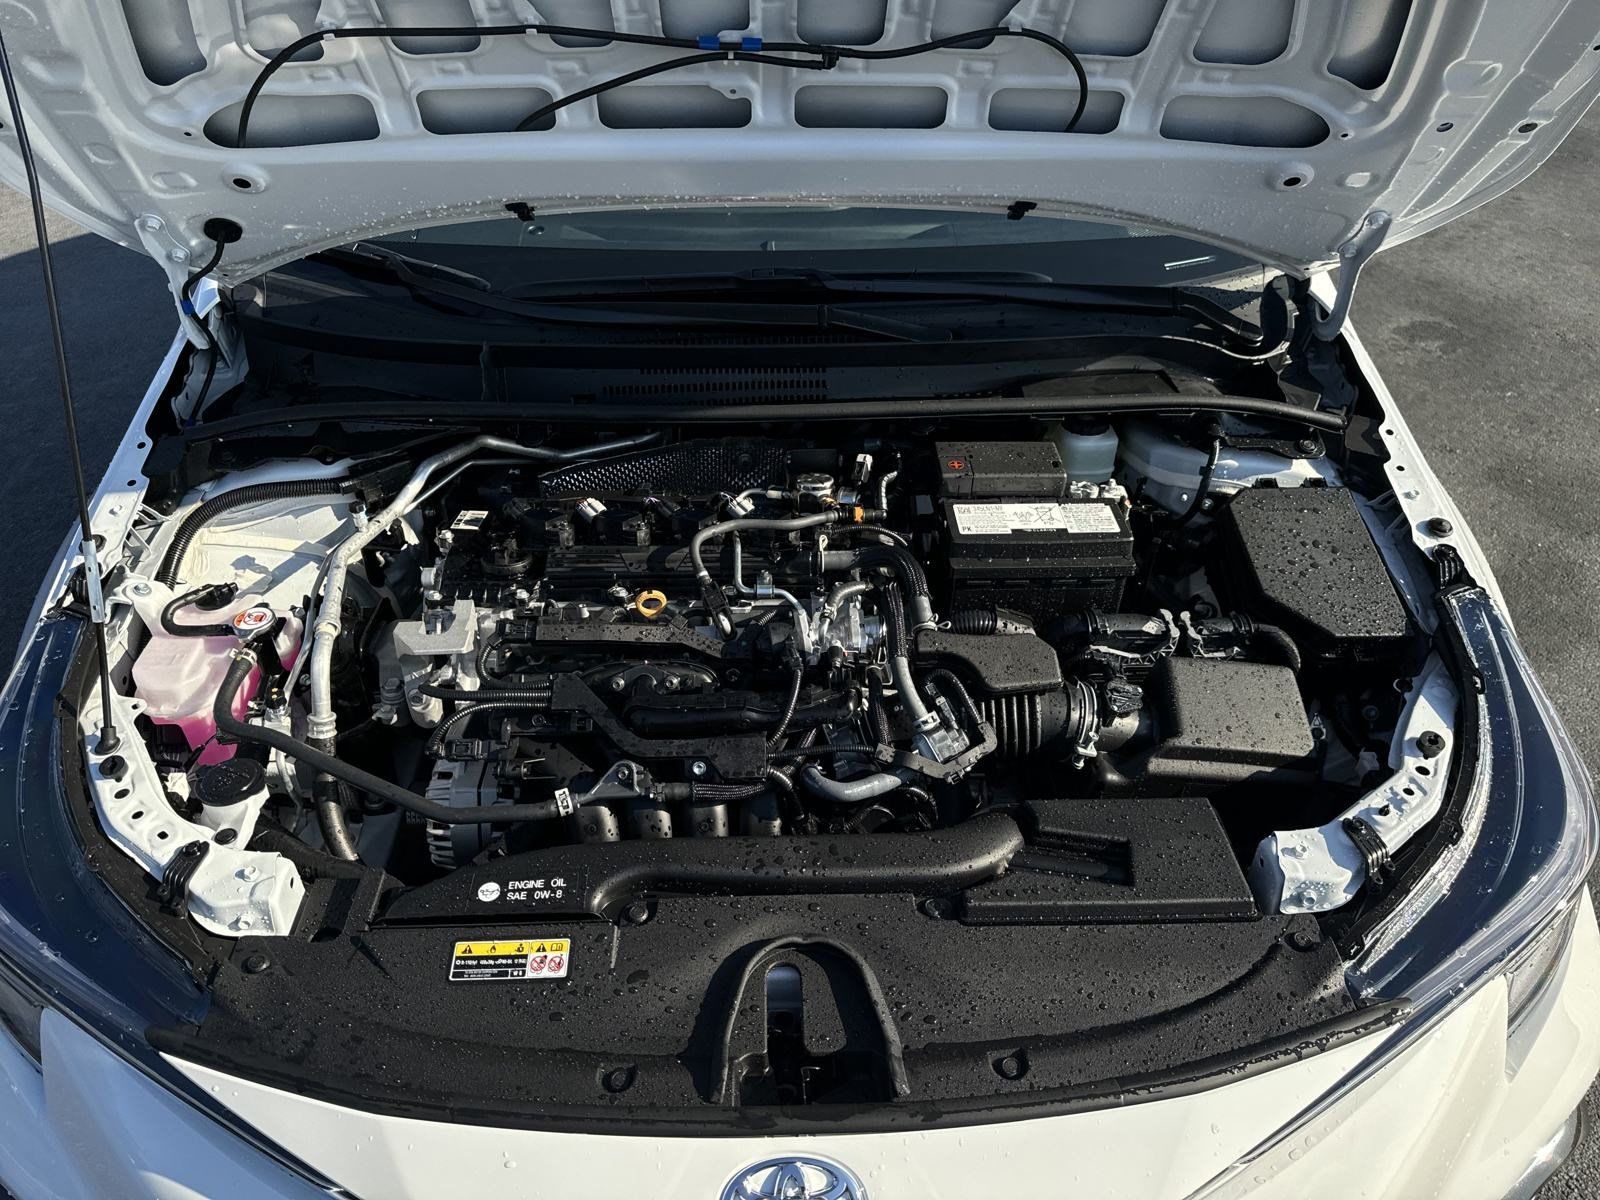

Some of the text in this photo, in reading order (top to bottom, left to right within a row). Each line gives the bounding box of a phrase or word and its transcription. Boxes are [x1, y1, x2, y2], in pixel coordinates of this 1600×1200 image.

[508, 878, 567, 890] ENGINE OIL
[506, 890, 563, 900] SAE 0W-8
